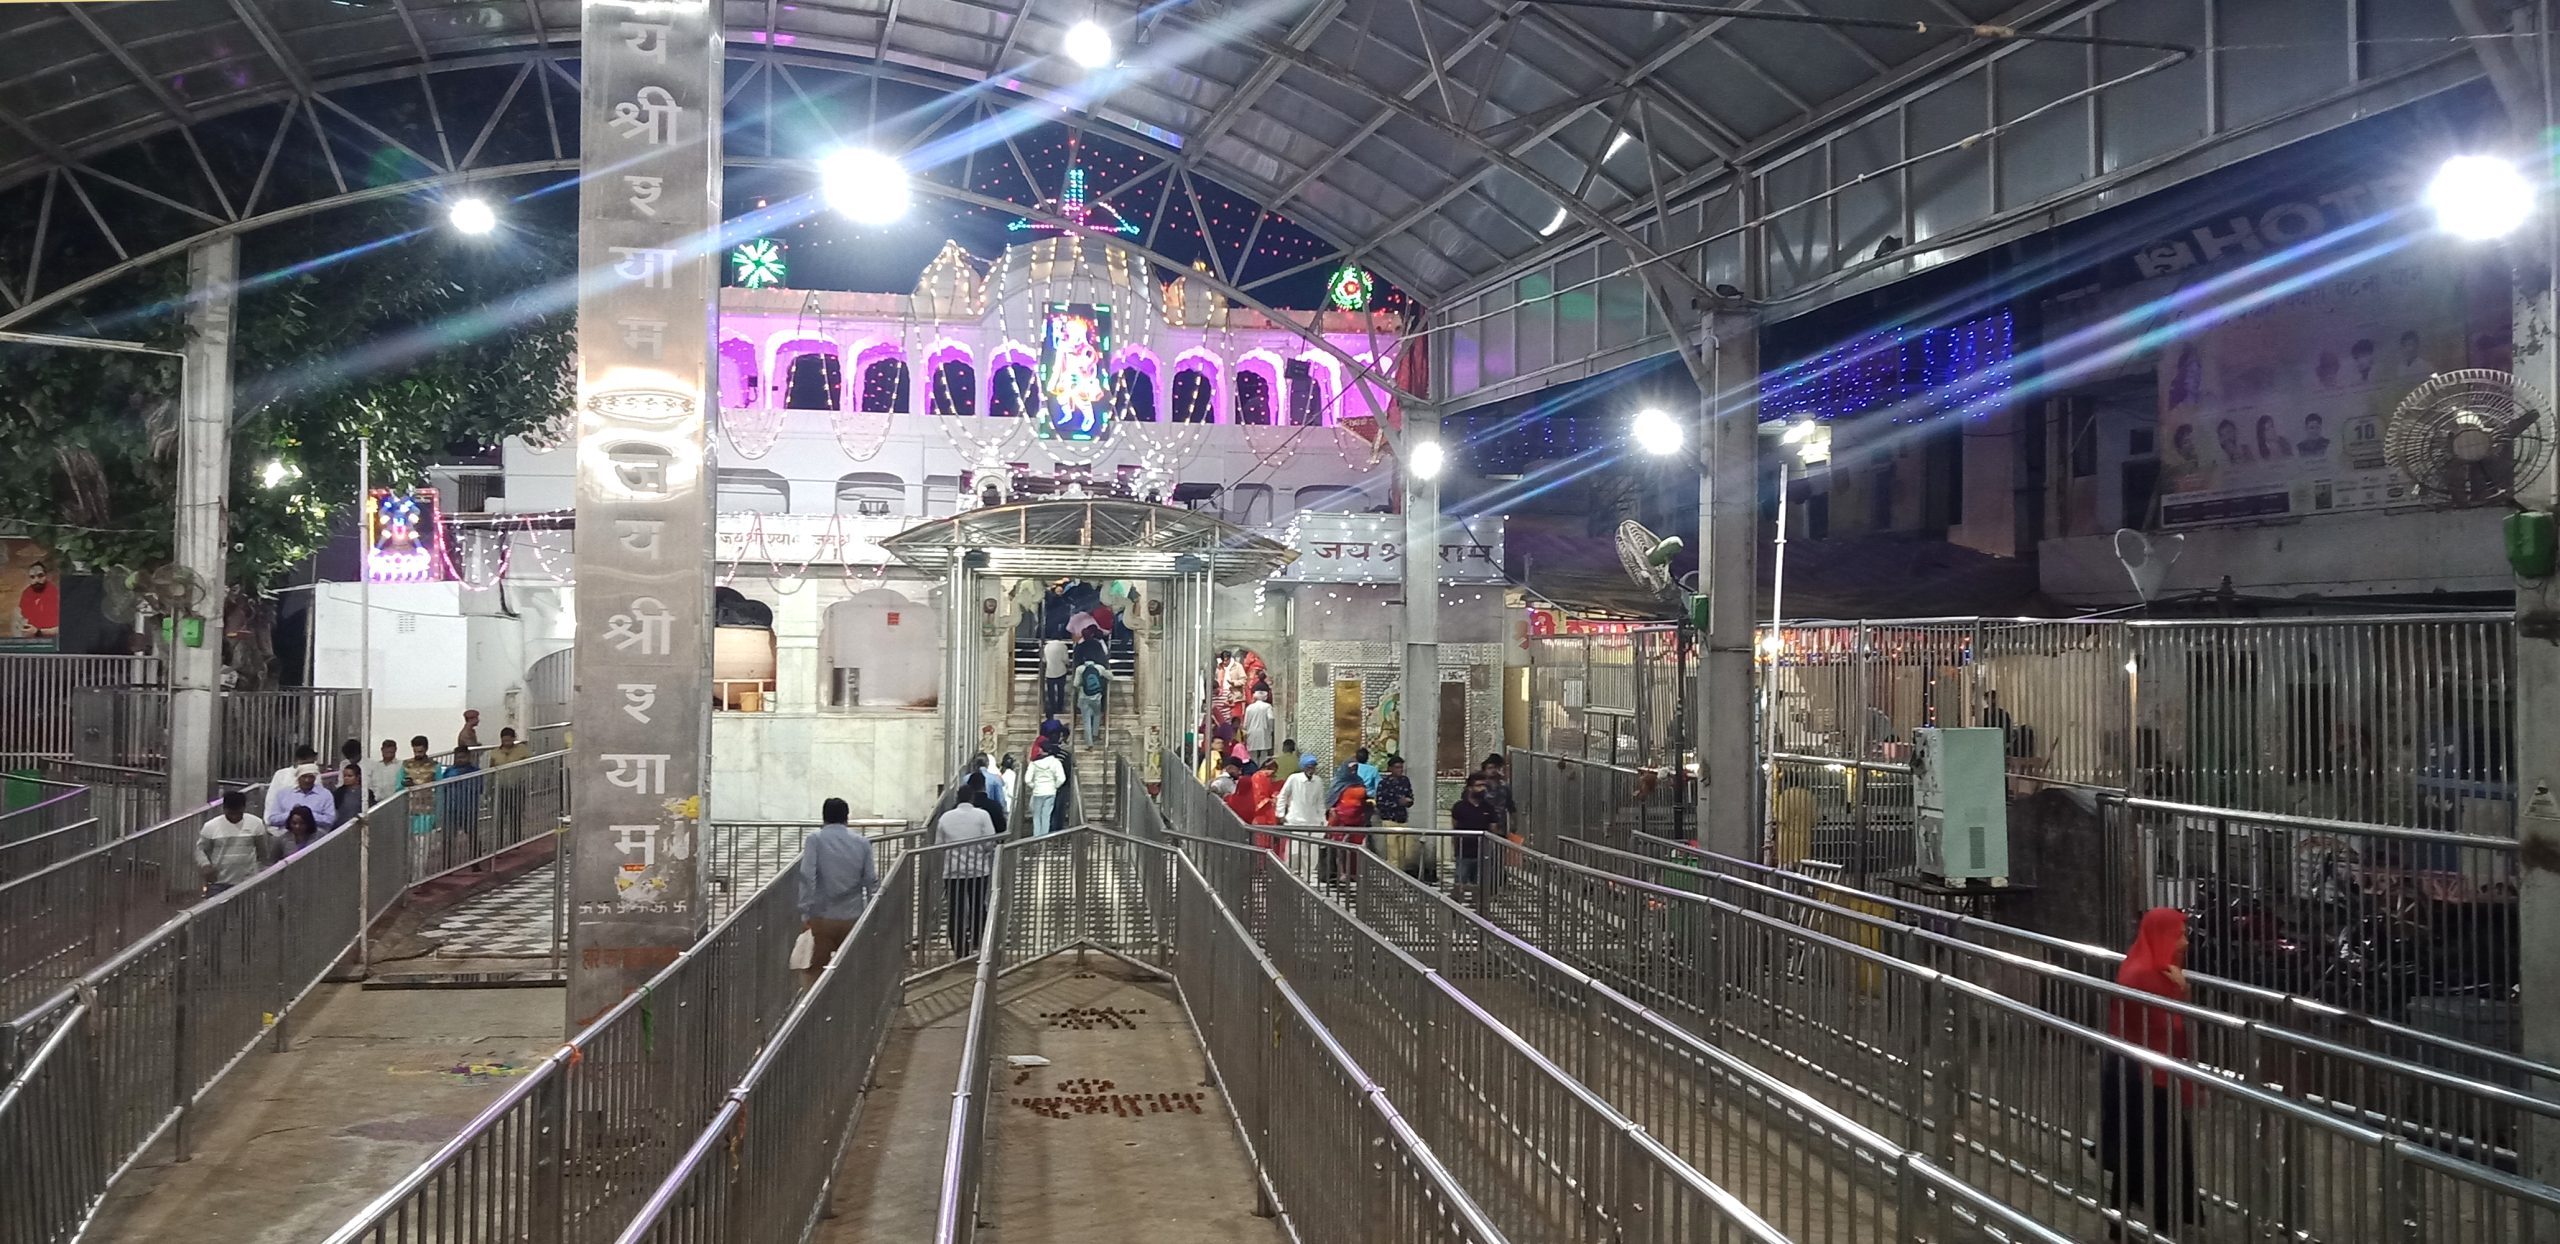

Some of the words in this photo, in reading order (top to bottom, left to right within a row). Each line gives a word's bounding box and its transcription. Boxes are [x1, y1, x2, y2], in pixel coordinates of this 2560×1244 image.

[2354, 423, 2375, 440] 10
[1309, 542, 1377, 562] जय
[1438, 544, 1493, 563] राम
